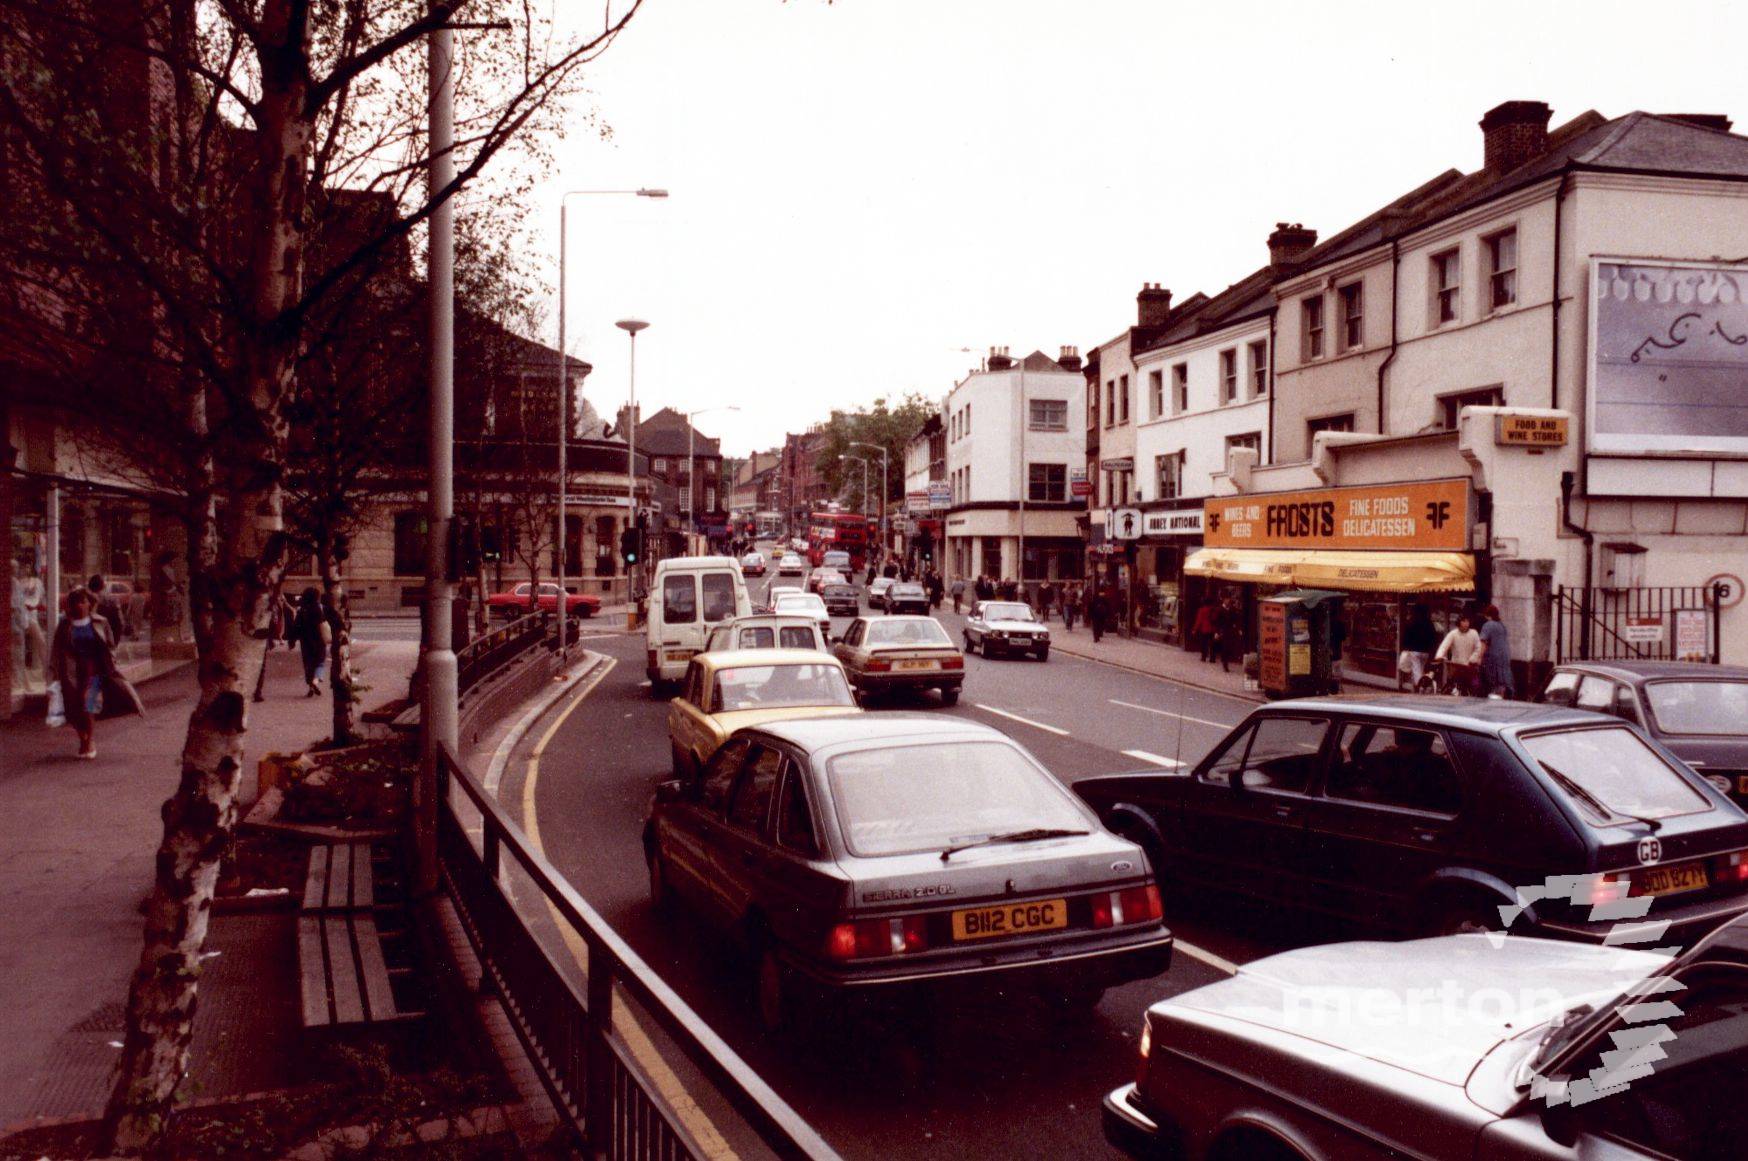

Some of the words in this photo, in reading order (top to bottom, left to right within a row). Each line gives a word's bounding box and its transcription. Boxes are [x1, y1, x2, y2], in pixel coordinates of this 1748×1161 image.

[1515, 420, 1536, 430] FOOD
[1541, 421, 1556, 430] AND
[1508, 431, 1527, 441] WINE
[1532, 431, 1563, 441] STORES
[1224, 506, 1243, 521] WINES
[1246, 505, 1260, 520] AND
[1350, 498, 1370, 516] FINE
[1373, 497, 1409, 515] FOODS
[1149, 517, 1168, 530] ABBEY
[1169, 516, 1202, 529] NATIONAL
[1267, 501, 1335, 538] FROSTS
[1343, 517, 1416, 537] DELICATESSEN
[1231, 523, 1252, 538] BEERS
[1640, 842, 1659, 861] GB
[965, 912, 1007, 935] B112
[1012, 905, 1055, 929] CGC
